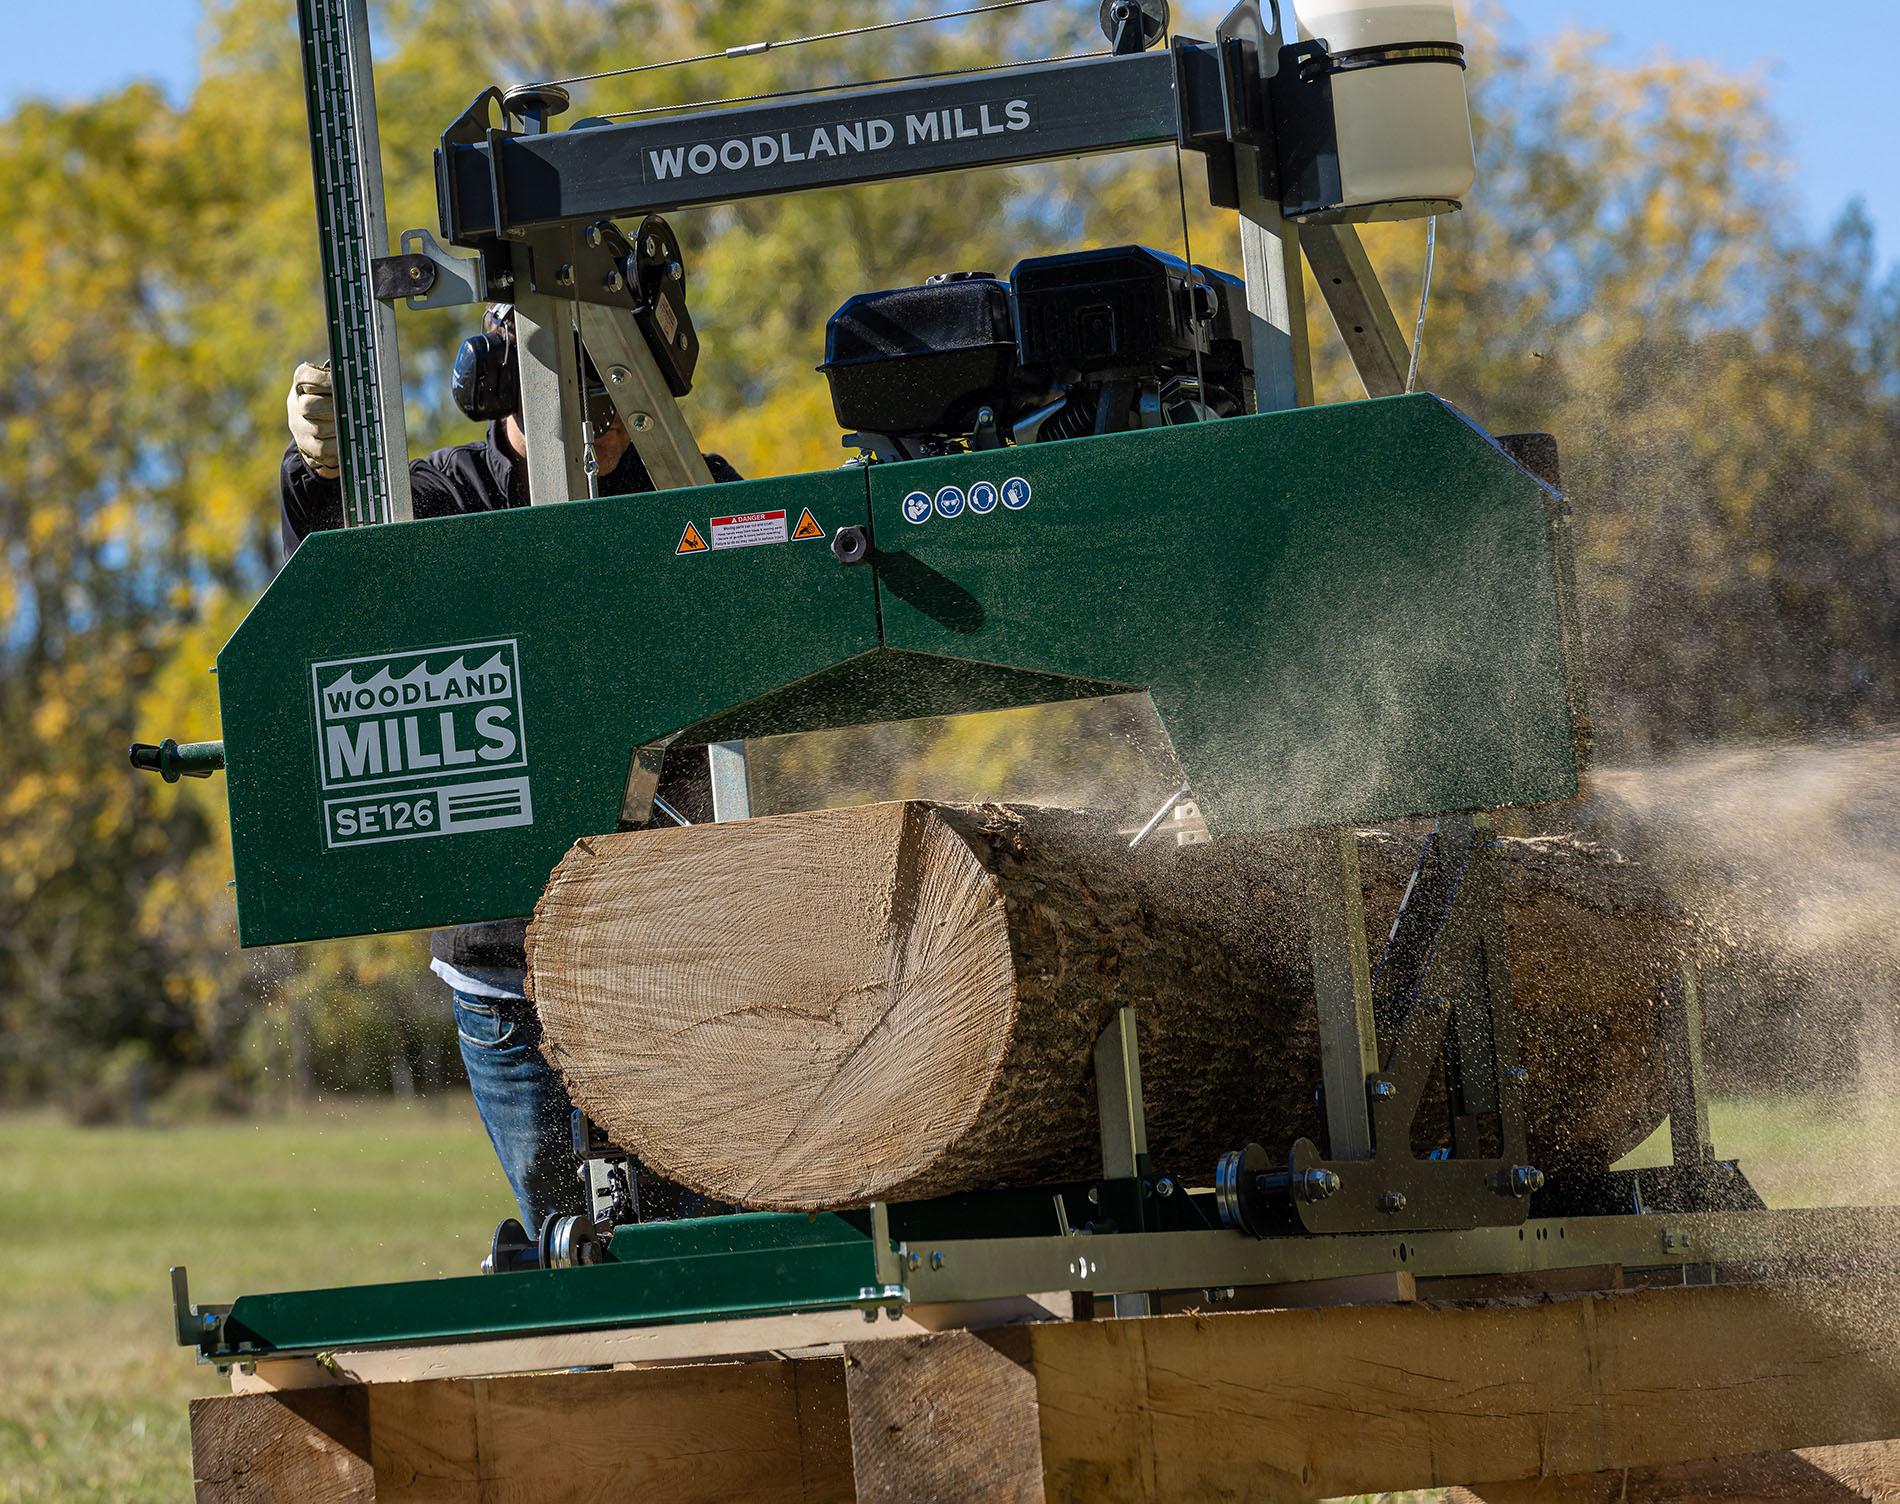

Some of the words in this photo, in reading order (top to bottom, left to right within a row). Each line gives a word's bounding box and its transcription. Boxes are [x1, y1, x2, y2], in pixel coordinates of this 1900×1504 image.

[649, 118, 895, 180] WOODLAND
[905, 99, 1031, 145] MILLS
[738, 513, 765, 522] DANGER
[327, 672, 507, 713] WOODLAND
[326, 705, 517, 779] MILLS
[336, 799, 434, 836] SE126
